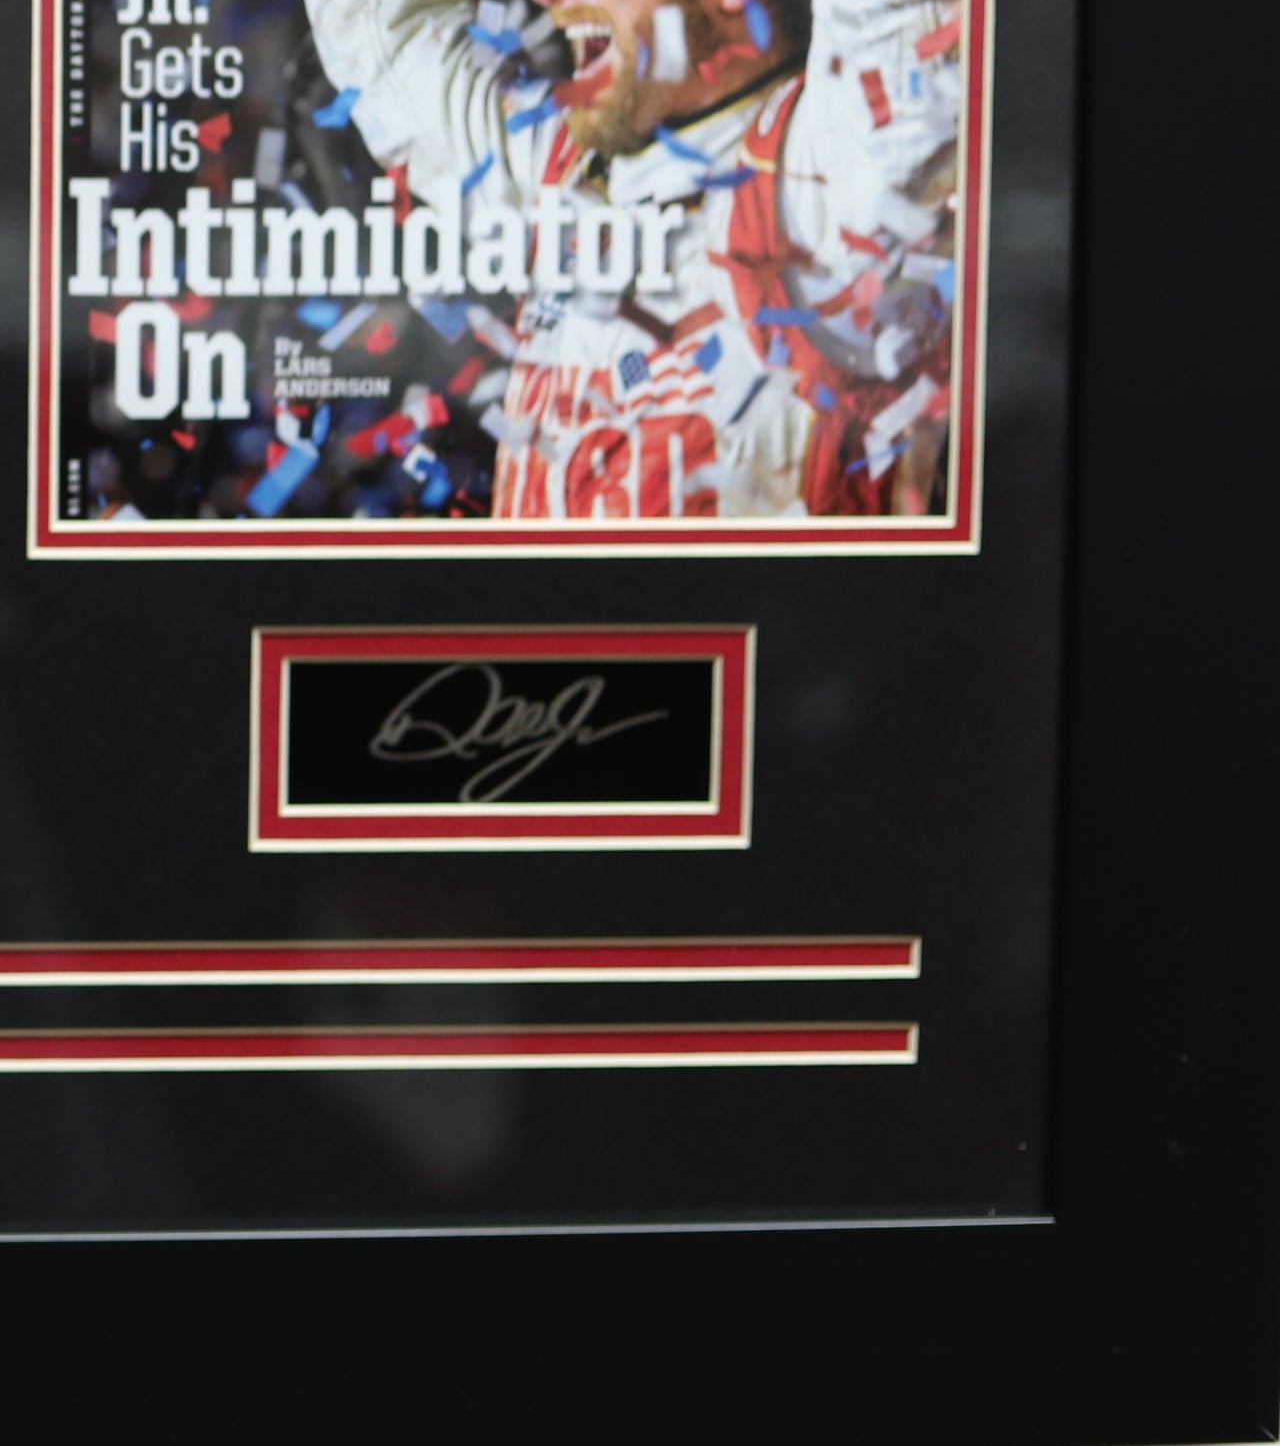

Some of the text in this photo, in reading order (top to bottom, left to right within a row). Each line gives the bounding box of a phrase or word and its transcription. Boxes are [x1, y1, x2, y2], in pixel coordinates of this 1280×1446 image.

[119, 28, 243, 99] Gets
[119, 101, 200, 172] His
[67, 177, 683, 297] Intimidator
[115, 301, 250, 420] On
[274, 336, 303, 359] By
[274, 355, 331, 377] LARS
[274, 375, 390, 398] ANDERSON
